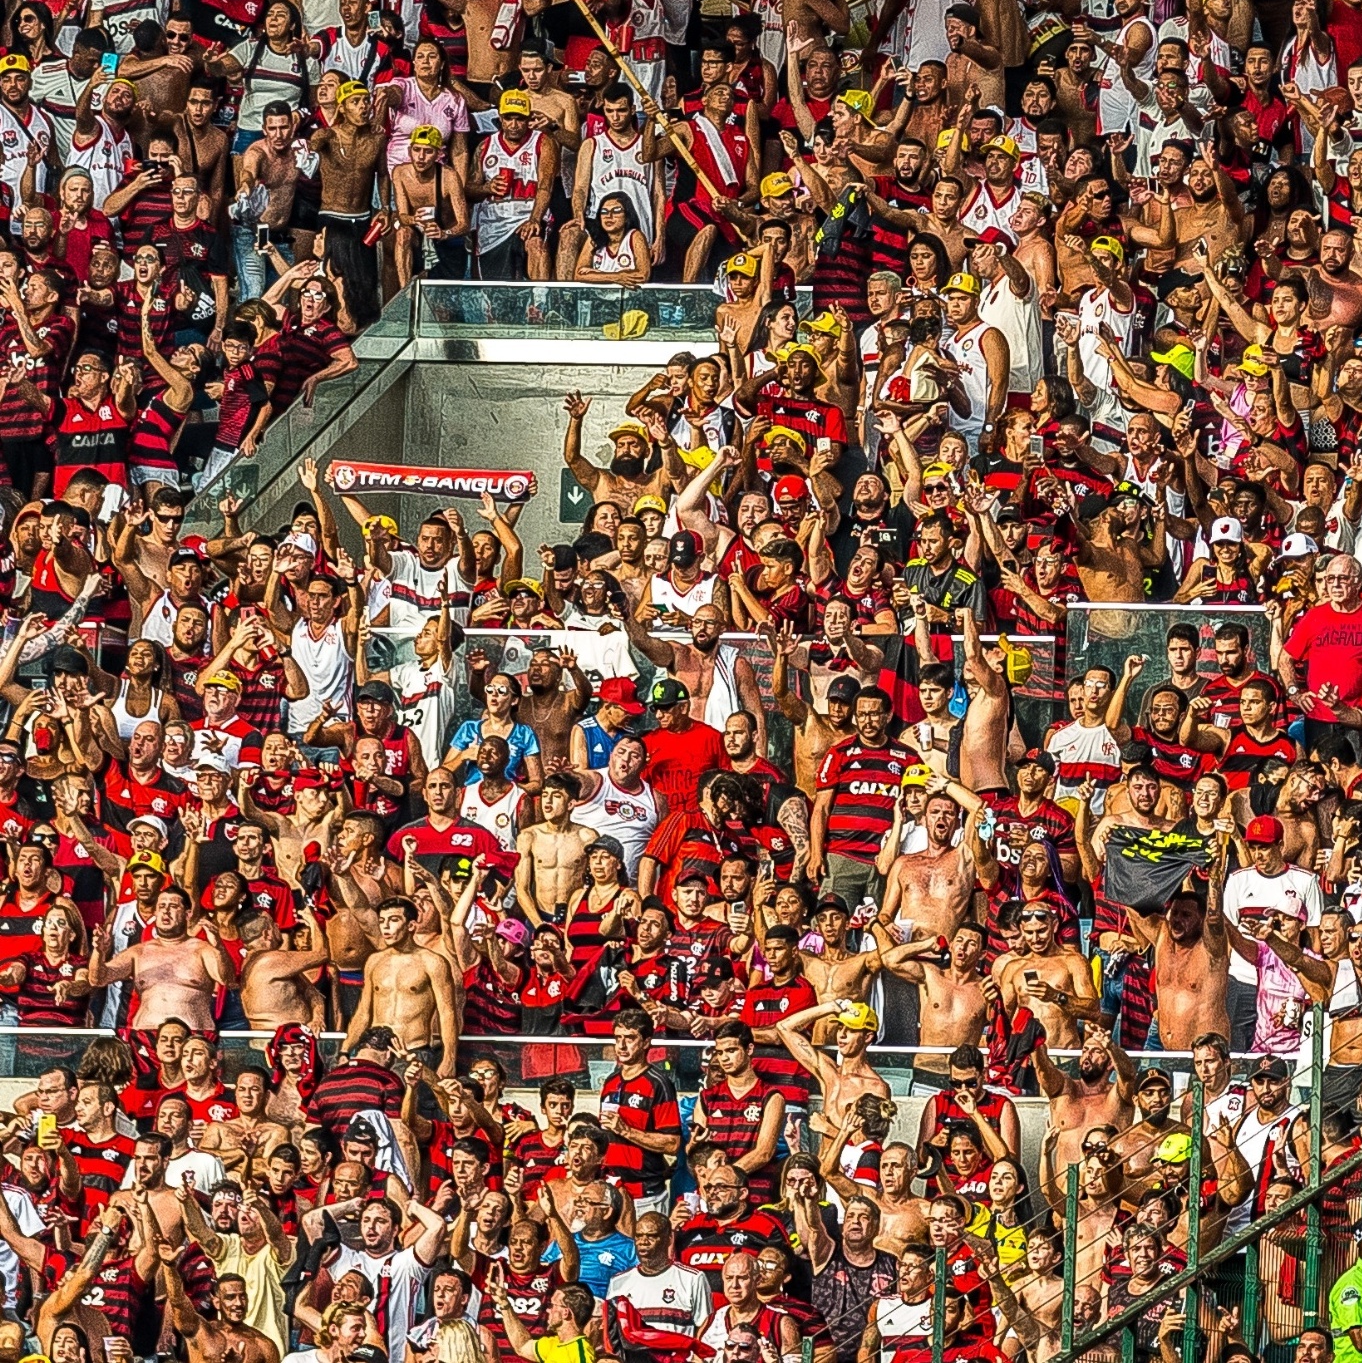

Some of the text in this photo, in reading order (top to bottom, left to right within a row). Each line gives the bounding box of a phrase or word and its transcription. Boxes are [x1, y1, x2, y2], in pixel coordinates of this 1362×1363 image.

[358, 470, 502, 495] TFM BANGU
[849, 780, 900, 799] CAIXA
[451, 833, 473, 847] 92
[690, 1252, 728, 1266] CAIX
